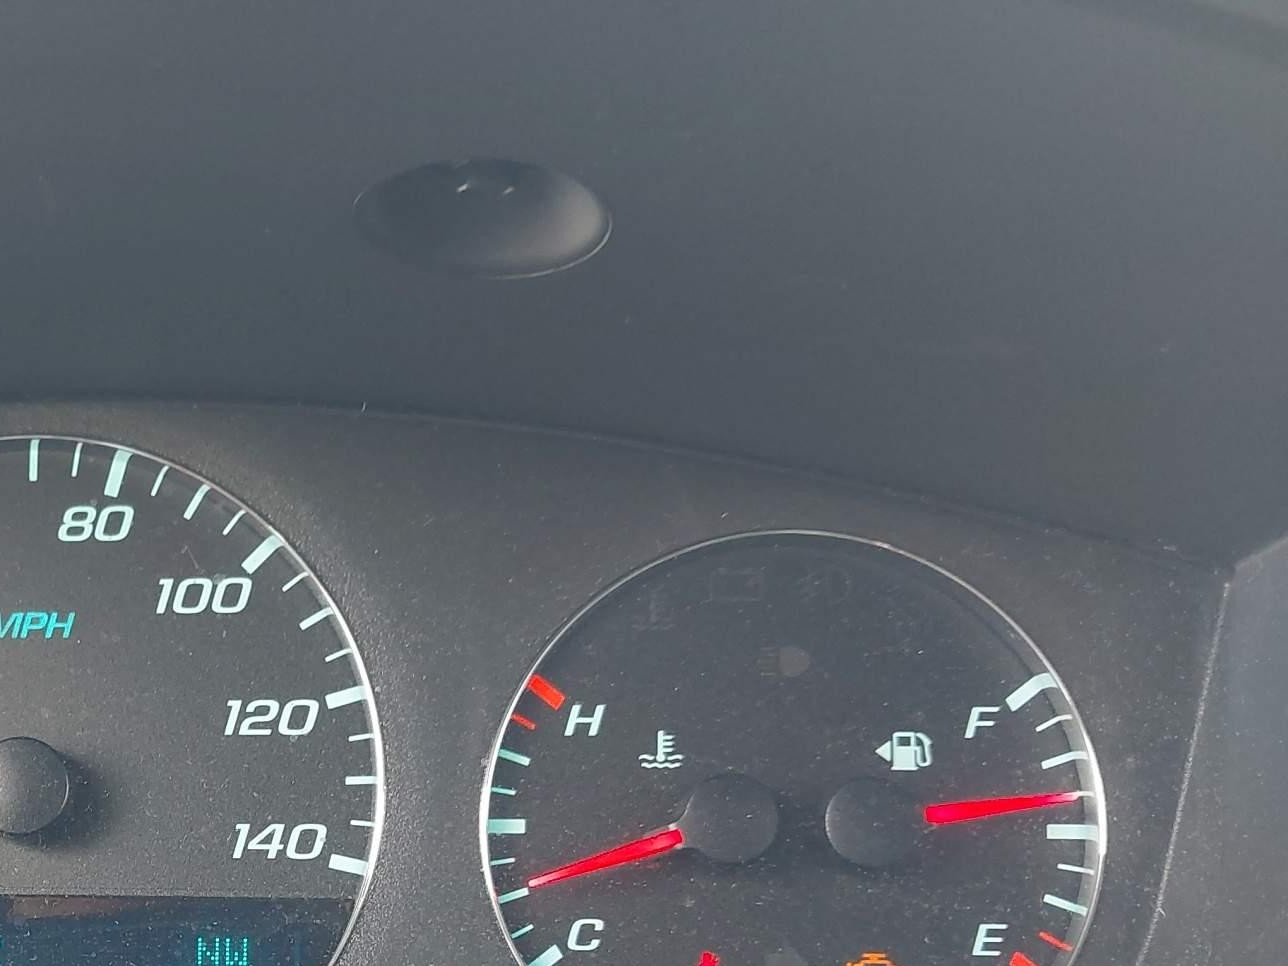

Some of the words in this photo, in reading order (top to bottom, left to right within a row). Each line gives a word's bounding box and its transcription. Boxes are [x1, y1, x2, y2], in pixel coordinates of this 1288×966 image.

[57, 505, 134, 542] 80
[155, 577, 252, 615] 100
[224, 699, 319, 736] 120
[564, 705, 606, 737] H
[964, 706, 1001, 738] F
[232, 822, 327, 860] 140
[567, 919, 605, 952] C
[971, 924, 1008, 956] E
